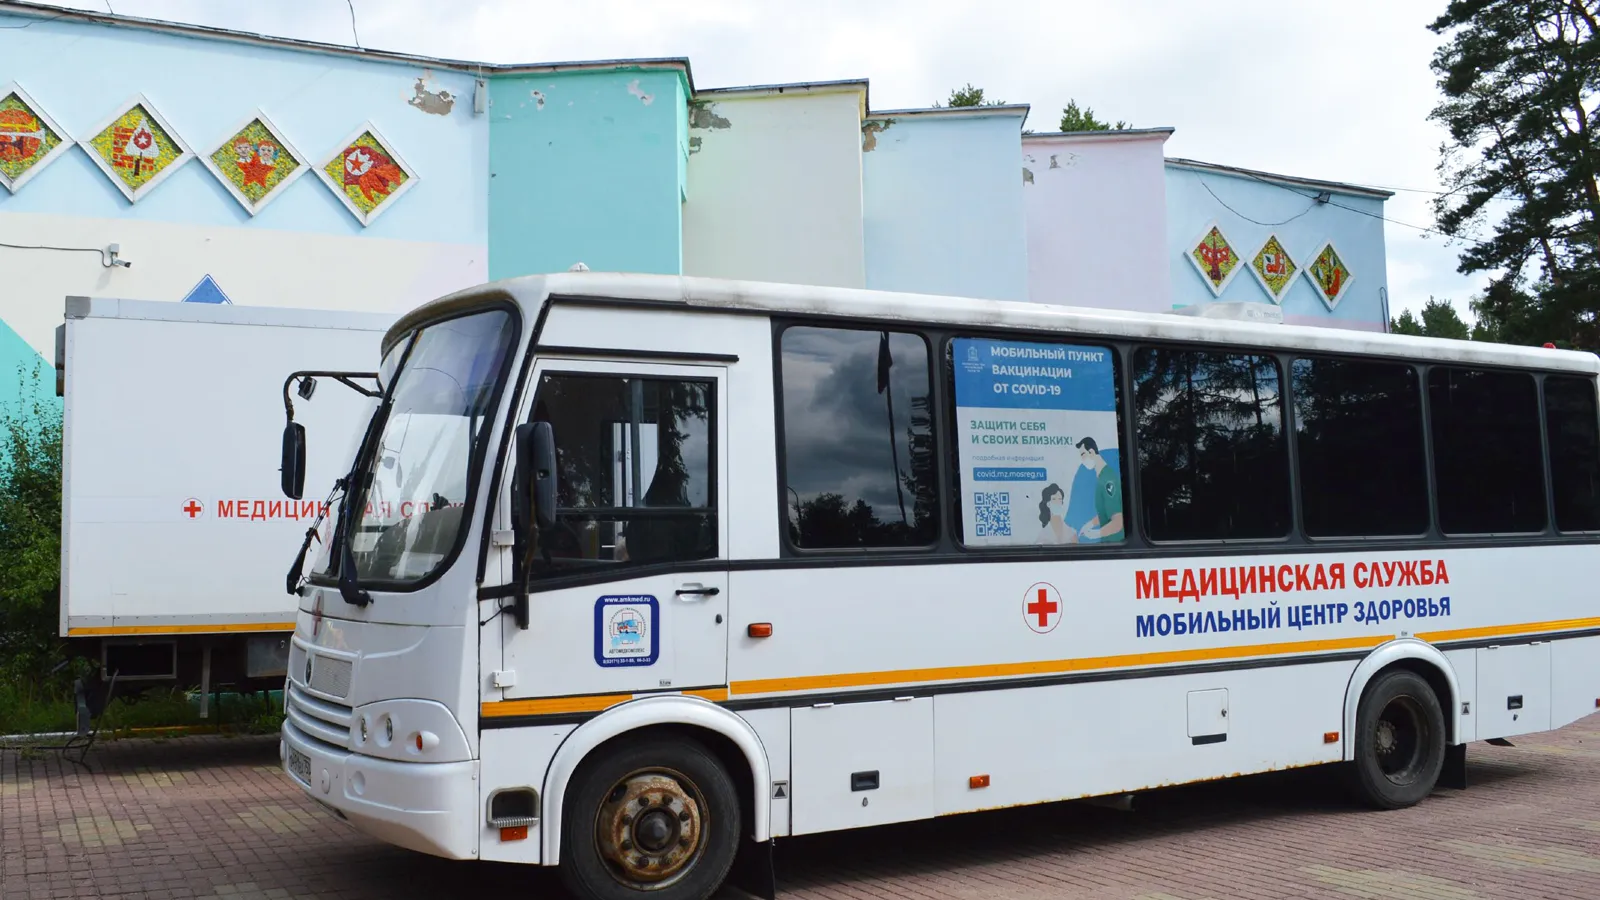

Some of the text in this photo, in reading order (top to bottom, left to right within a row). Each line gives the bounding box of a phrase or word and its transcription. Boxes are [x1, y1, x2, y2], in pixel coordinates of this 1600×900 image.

[990, 346, 1105, 363] МОБИЛЬНЫЙ ПУНКТ
[991, 364, 1072, 379] ВАКЦИНАЦИИ
[993, 383, 1062, 396] ОТ COVID-19
[970, 420, 1046, 431] ЗАЩИТИ СЕБЯ
[971, 434, 1073, 446] И СВОИХ БЛИЗКИХ!
[976, 469, 1044, 479] covid.mz.mosreg.ru
[1135, 559, 1450, 603] МЕДИЦИНСКАЯ СЛУЖБА
[1136, 596, 1451, 638] МОБИЛЬНЫЙ ЦЕНТР ЗДОРОВЬЯ
